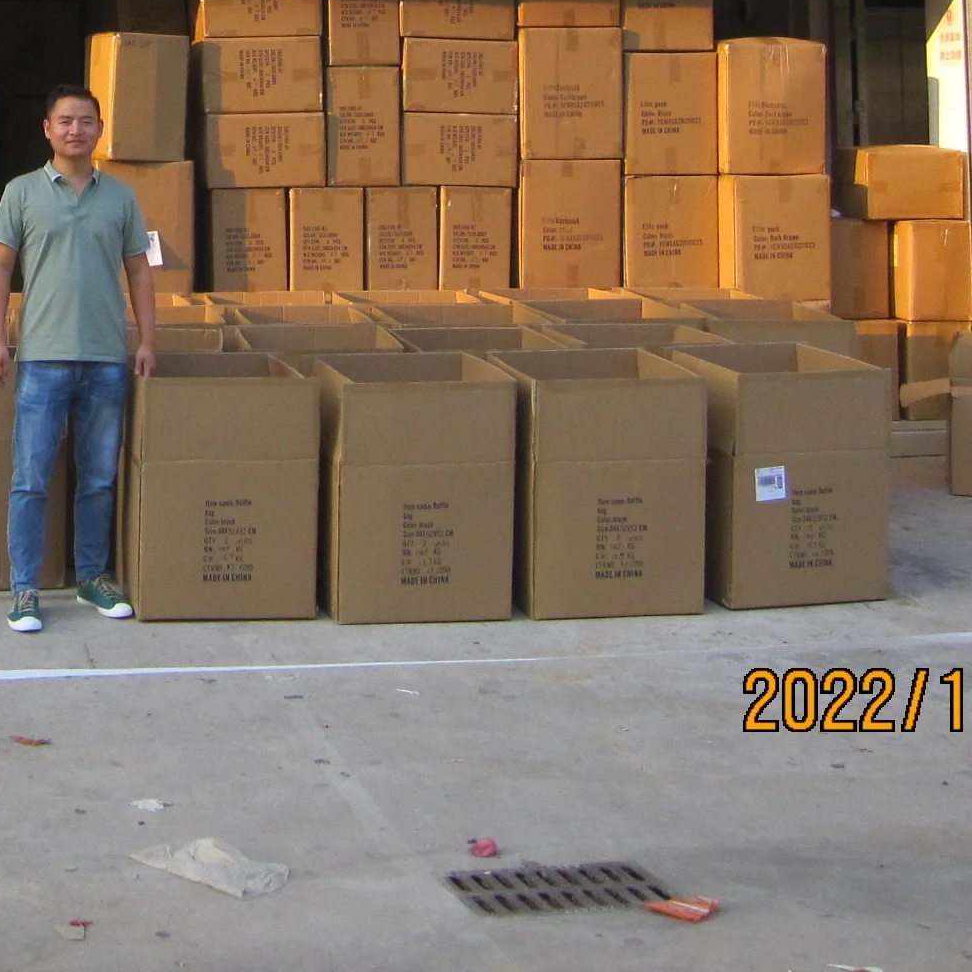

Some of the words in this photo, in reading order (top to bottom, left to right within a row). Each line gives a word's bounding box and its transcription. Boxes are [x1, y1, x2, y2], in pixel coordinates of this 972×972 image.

[790, 560, 805, 568] MADE
[815, 559, 832, 567] CHINA
[203, 574, 220, 582] MADE
[232, 573, 252, 582] CHINA
[596, 571, 613, 579] MADE
[615, 570, 621, 578] IN
[401, 576, 418, 584] MADE
[420, 576, 428, 584] IN
[429, 576, 448, 584] CHINA
